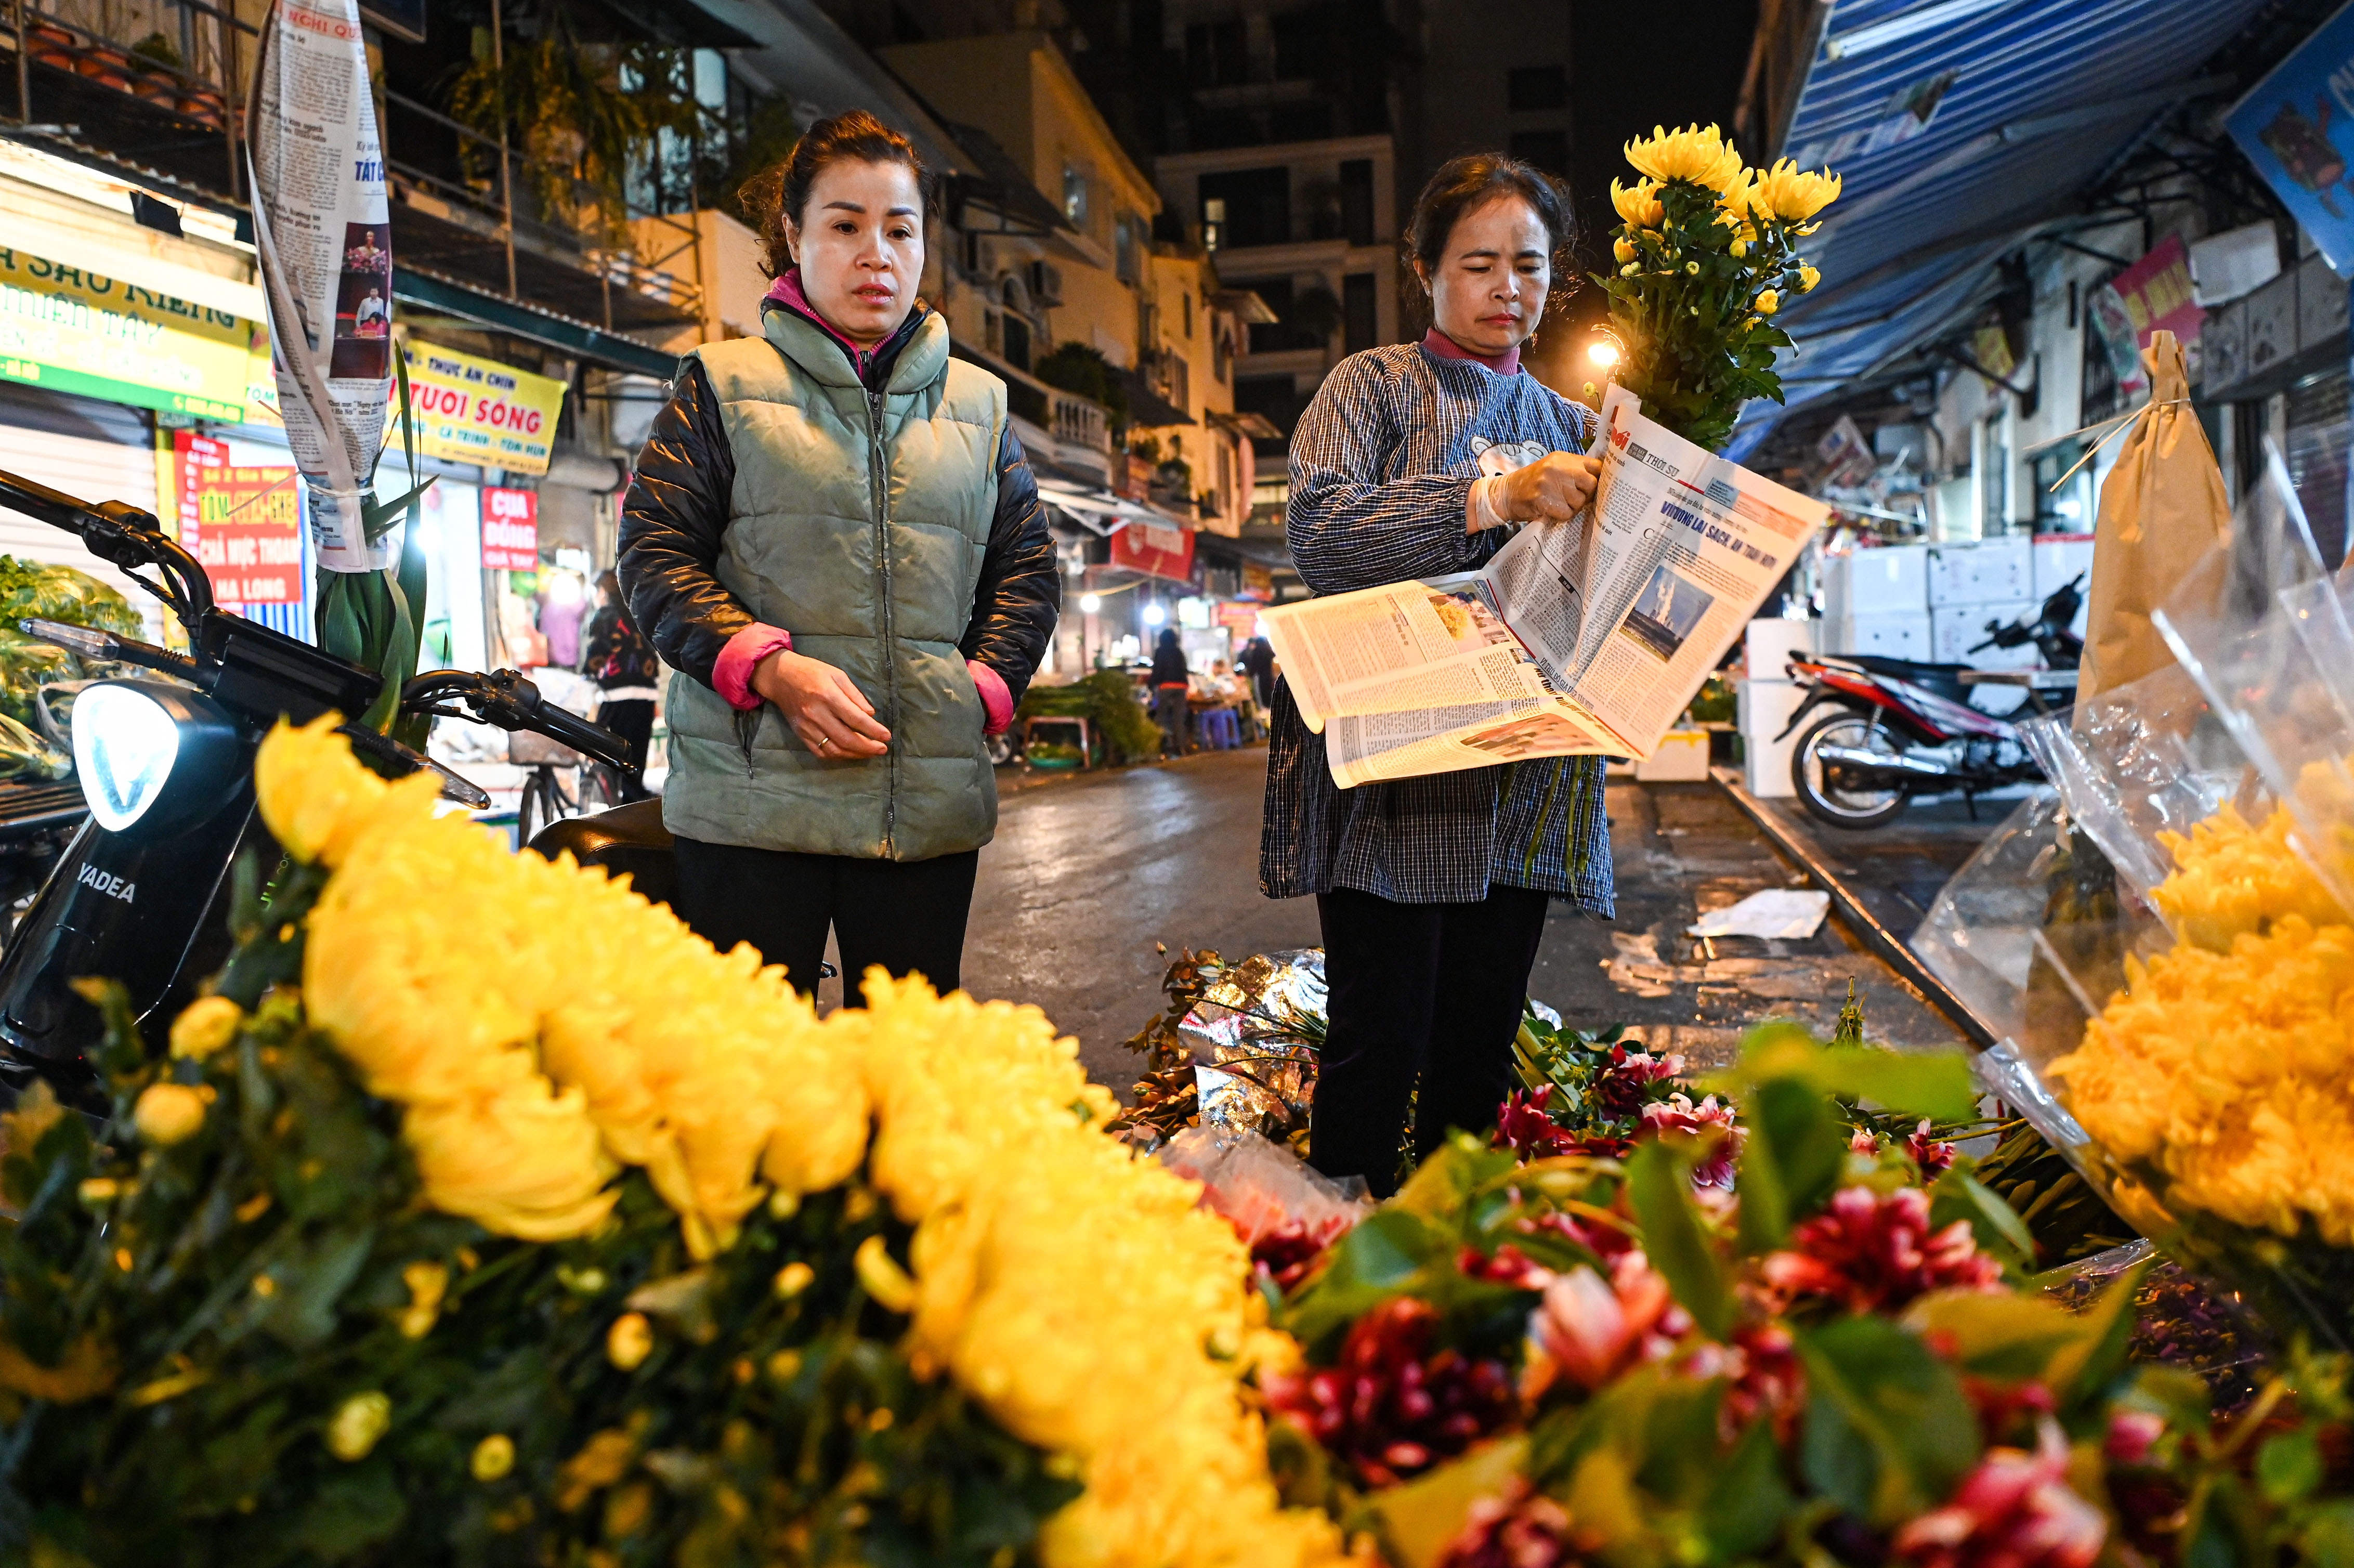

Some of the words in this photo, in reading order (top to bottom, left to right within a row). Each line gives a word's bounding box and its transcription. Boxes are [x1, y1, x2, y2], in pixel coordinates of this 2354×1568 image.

[355, 155, 375, 181] TẤT
[491, 491, 528, 518] CUA
[1691, 517, 1708, 534] LAI
[242, 577, 286, 600] LONG
[1540, 657, 1548, 666] VÌ
[1544, 662, 1555, 676] THỦ
[1553, 672, 1561, 682] ĐÔ
[76, 861, 136, 904] YADEA
